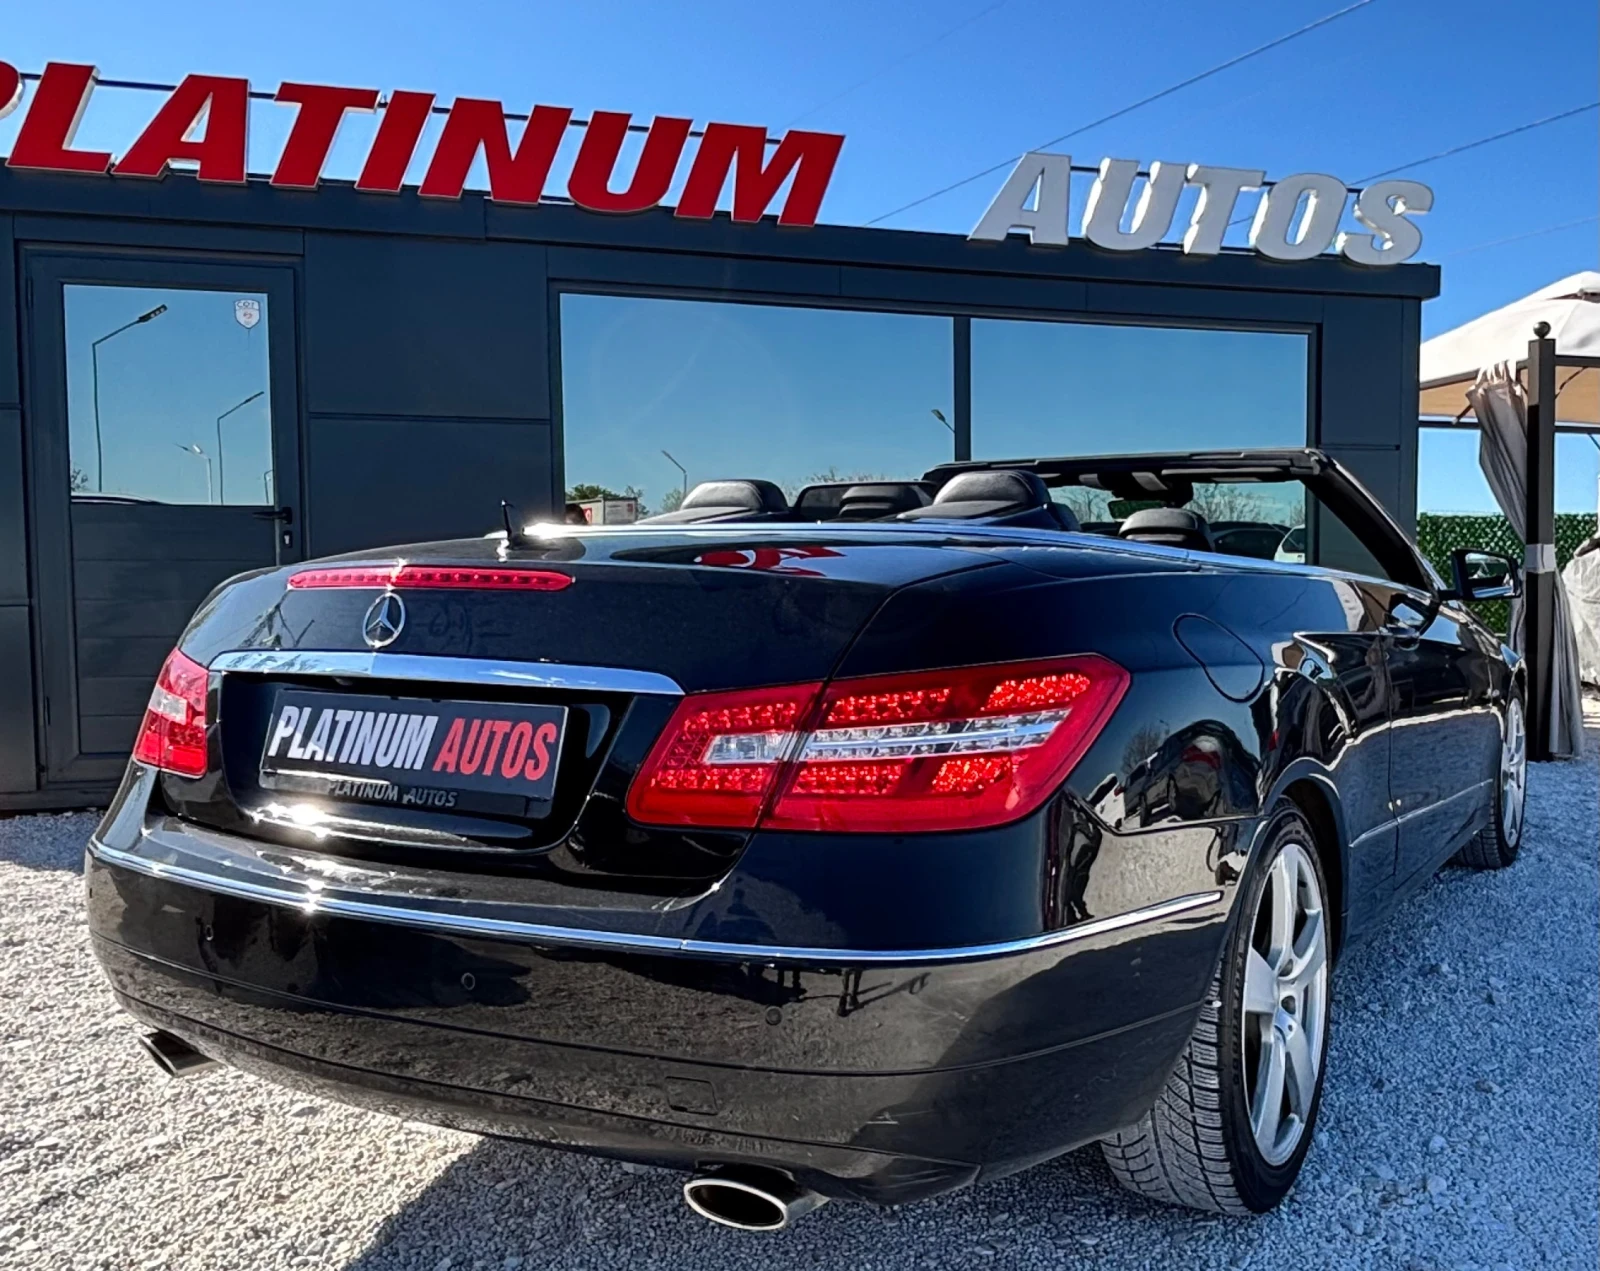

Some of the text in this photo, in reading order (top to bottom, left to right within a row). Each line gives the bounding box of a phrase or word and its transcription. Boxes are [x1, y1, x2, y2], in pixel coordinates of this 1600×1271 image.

[0, 60, 1434, 265] LATINUM AUTOS
[267, 705, 557, 781] PLATINUM AUTOS
[326, 780, 457, 806] PLATINUM AUTOS
